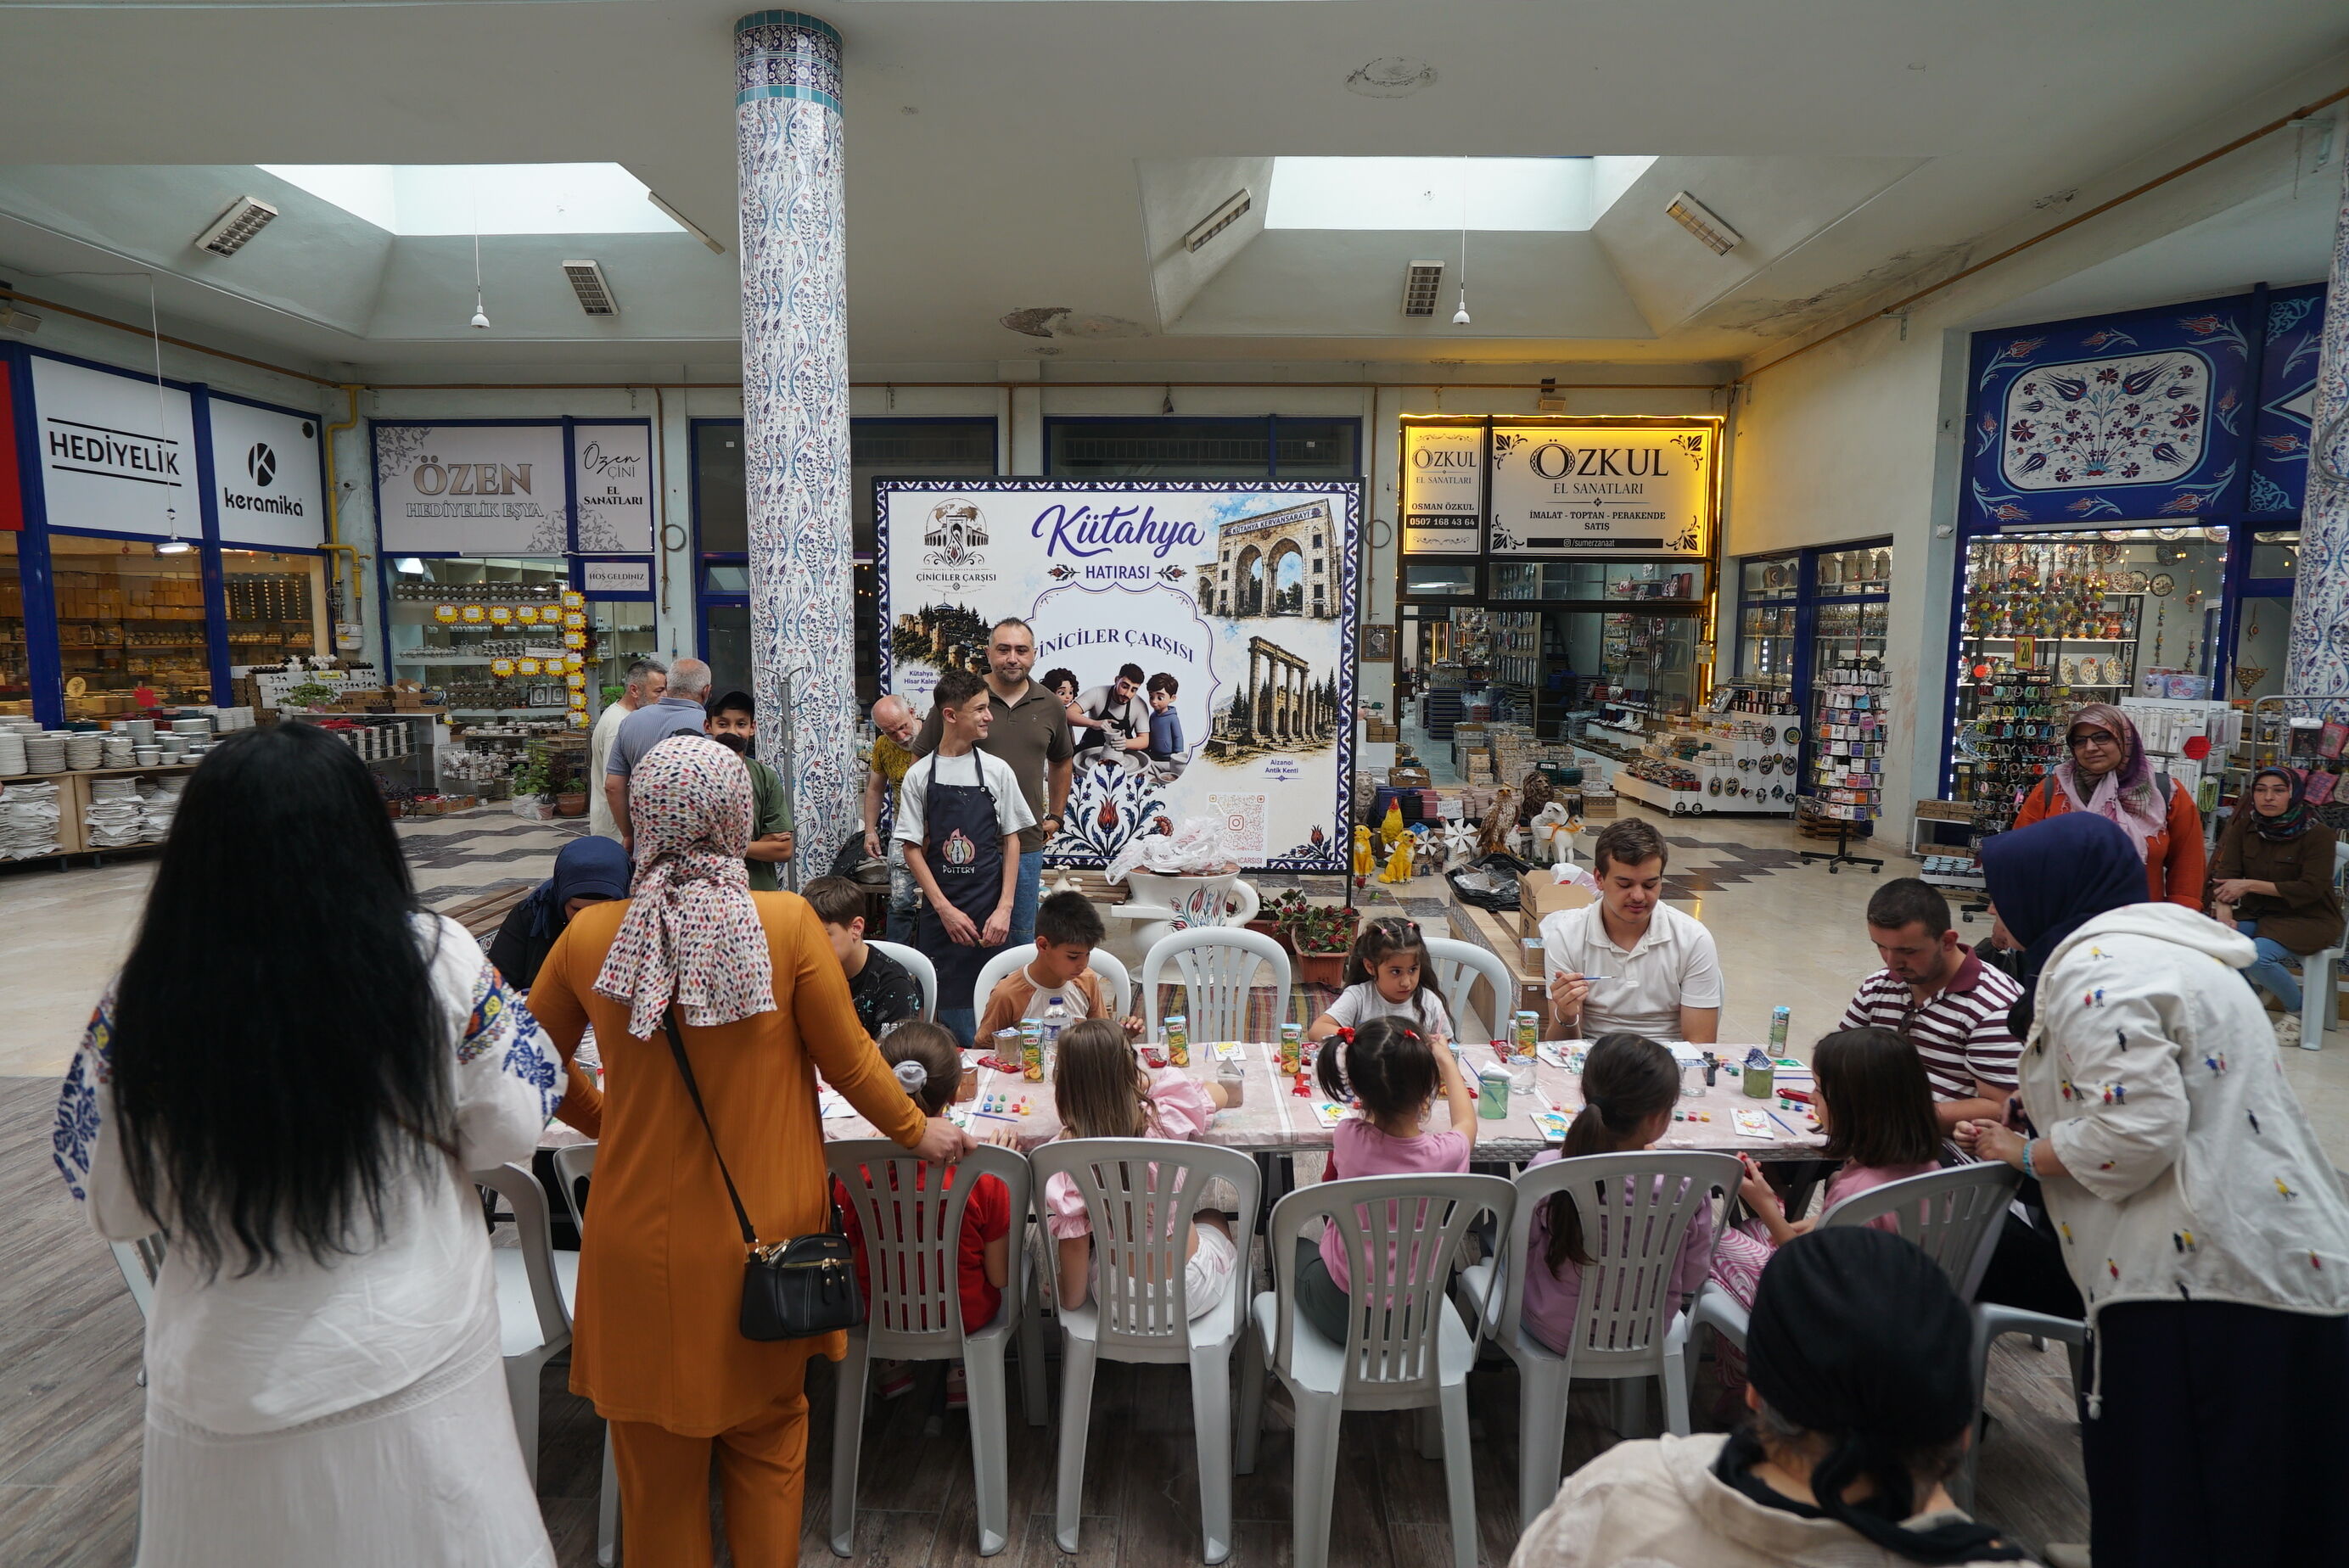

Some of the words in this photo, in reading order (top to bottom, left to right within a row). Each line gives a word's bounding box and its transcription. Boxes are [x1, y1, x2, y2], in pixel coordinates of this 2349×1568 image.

[49, 431, 180, 475] HEDİYELİK
[584, 440, 642, 474] Özen
[1412, 445, 1477, 469] ÖZKUL
[1530, 438, 1669, 480] ÖZKUL
[413, 455, 533, 496] ÖZEN
[608, 464, 635, 480] ÇİNİ
[1428, 476, 1472, 484] SANATLARI
[607, 485, 620, 495] EL
[1554, 483, 1568, 495] EL
[1573, 483, 1643, 495] SANATLARI
[224, 487, 304, 517] keramika
[583, 496, 643, 506] SANATLARI
[1411, 502, 1443, 511] OSMAN
[1445, 501, 1475, 511] ÖZKUL
[406, 500, 499, 517] HEDİYELİK
[502, 502, 545, 521] EŞYA
[1529, 509, 1563, 519] İMALAT
[1570, 511, 1605, 519] TOPTAN
[1612, 511, 1666, 520] PERAKENDE
[1410, 518, 1431, 526] 0507
[1433, 518, 1449, 526] 168
[1451, 518, 1462, 526] 43
[1584, 523, 1610, 531] SATIŞ
[1031, 504, 1205, 558] Kütahya
[917, 572, 961, 582] ÇİNİCİLER
[962, 574, 996, 583] ÇARŞISI
[1085, 565, 1151, 579] HATIRASI
[1124, 629, 1194, 664] ÇARŞISI
[942, 865, 975, 874] POTTERY
